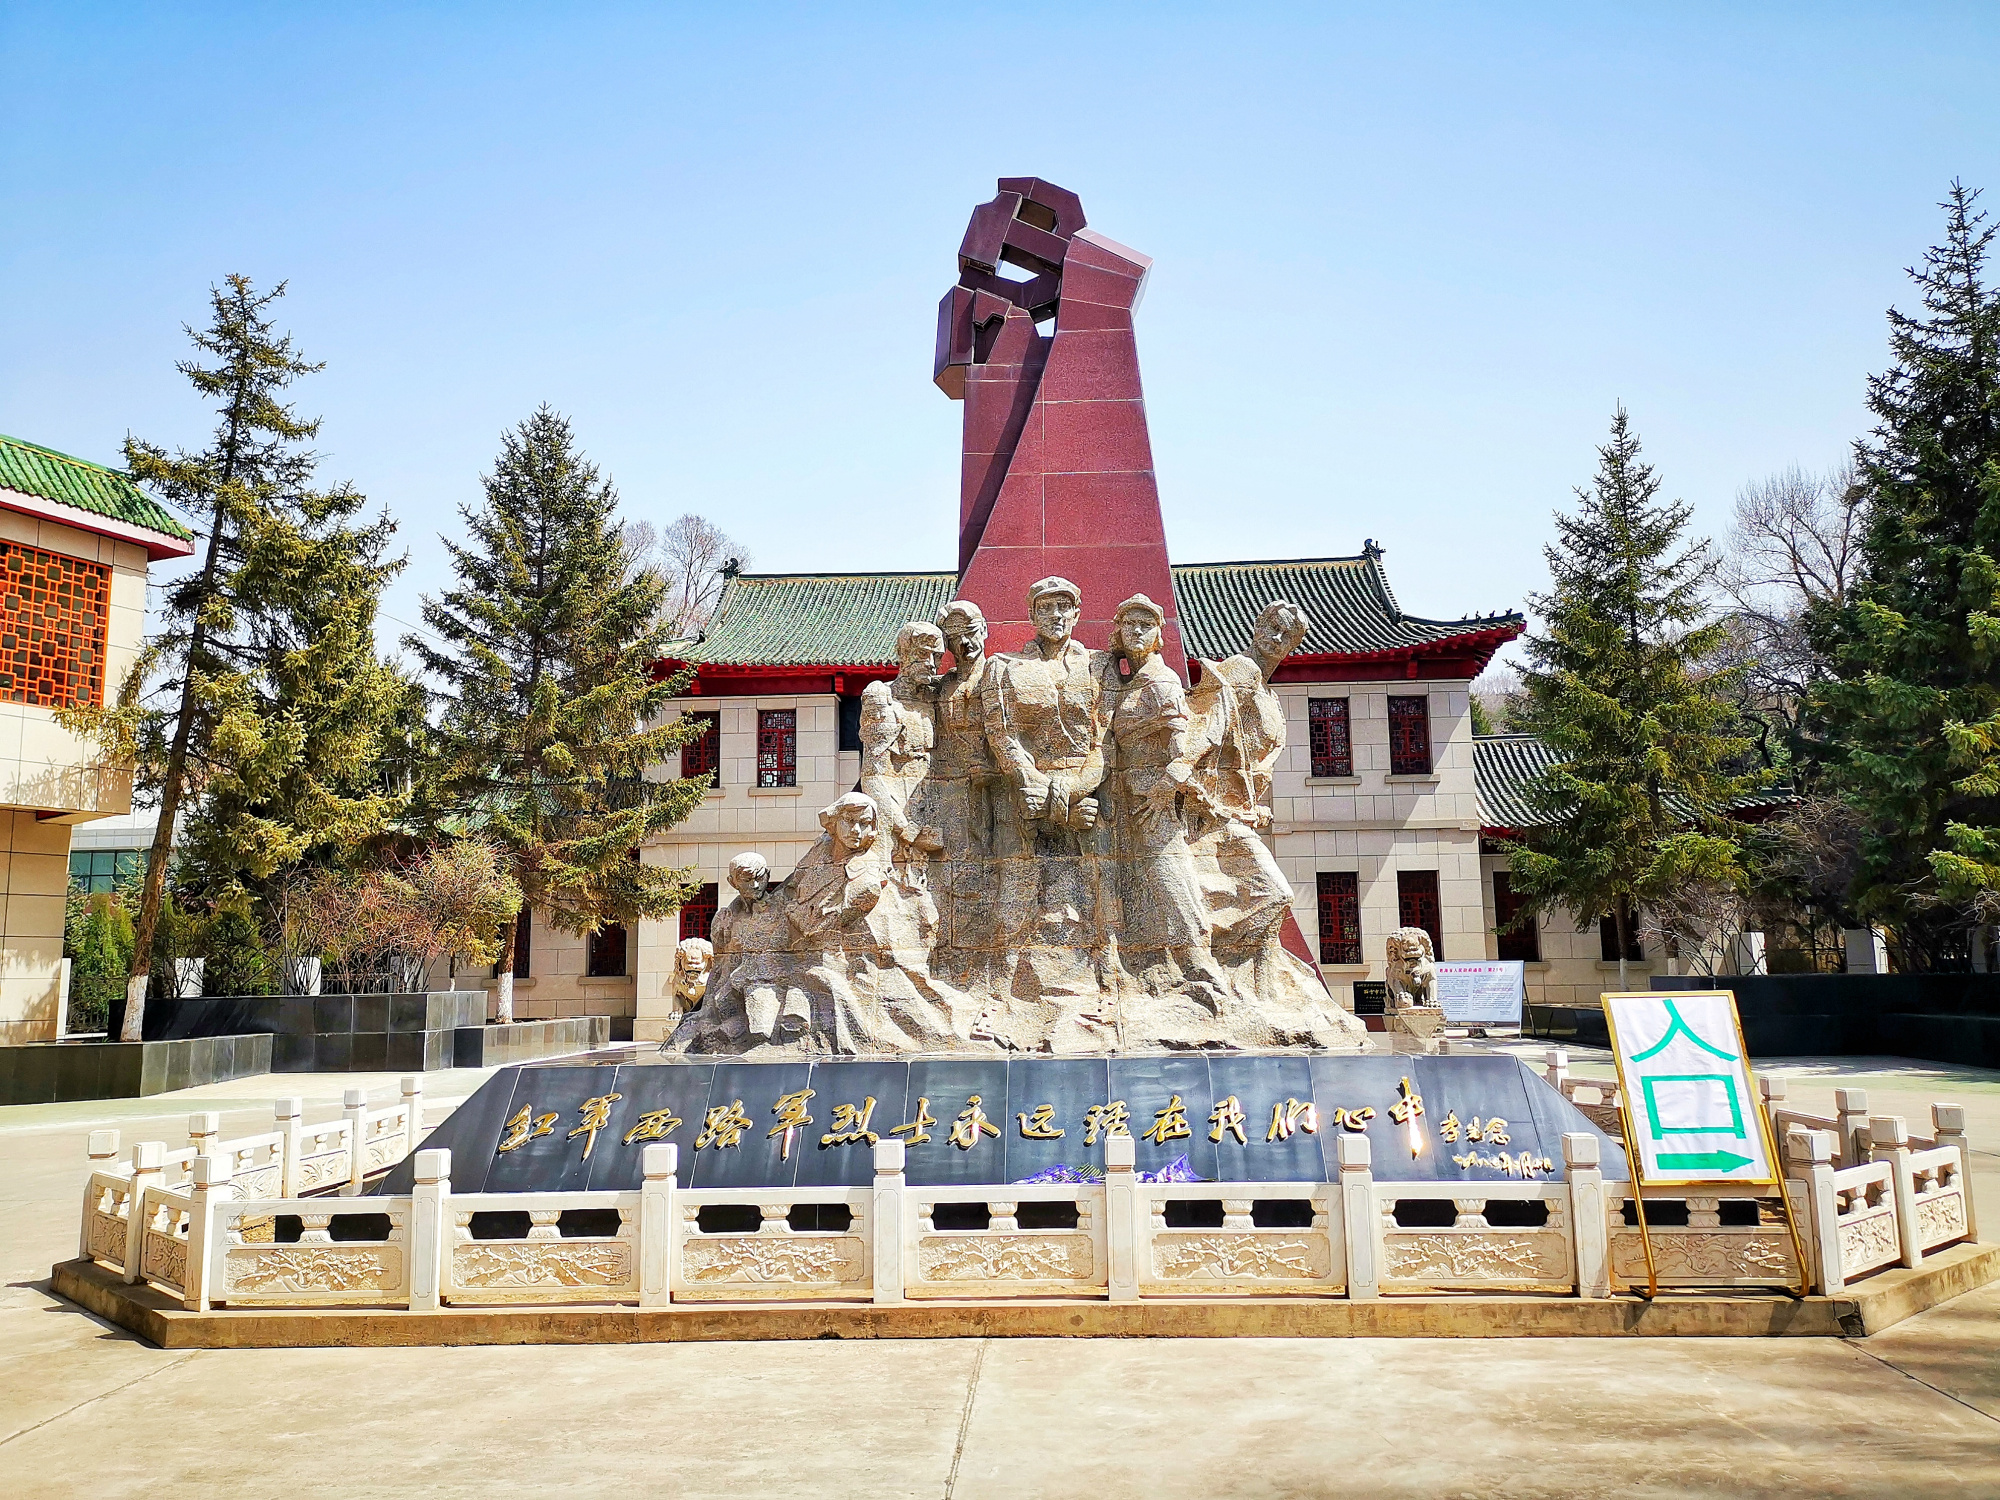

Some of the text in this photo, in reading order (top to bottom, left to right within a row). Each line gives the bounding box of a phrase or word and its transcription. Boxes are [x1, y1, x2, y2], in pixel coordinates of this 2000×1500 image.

[1629, 998, 1747, 1140] 入口
[497, 1077, 1425, 1162] 红军西路军烈士永远活在我们心中
[1440, 1109, 1511, 1145] 李先念
